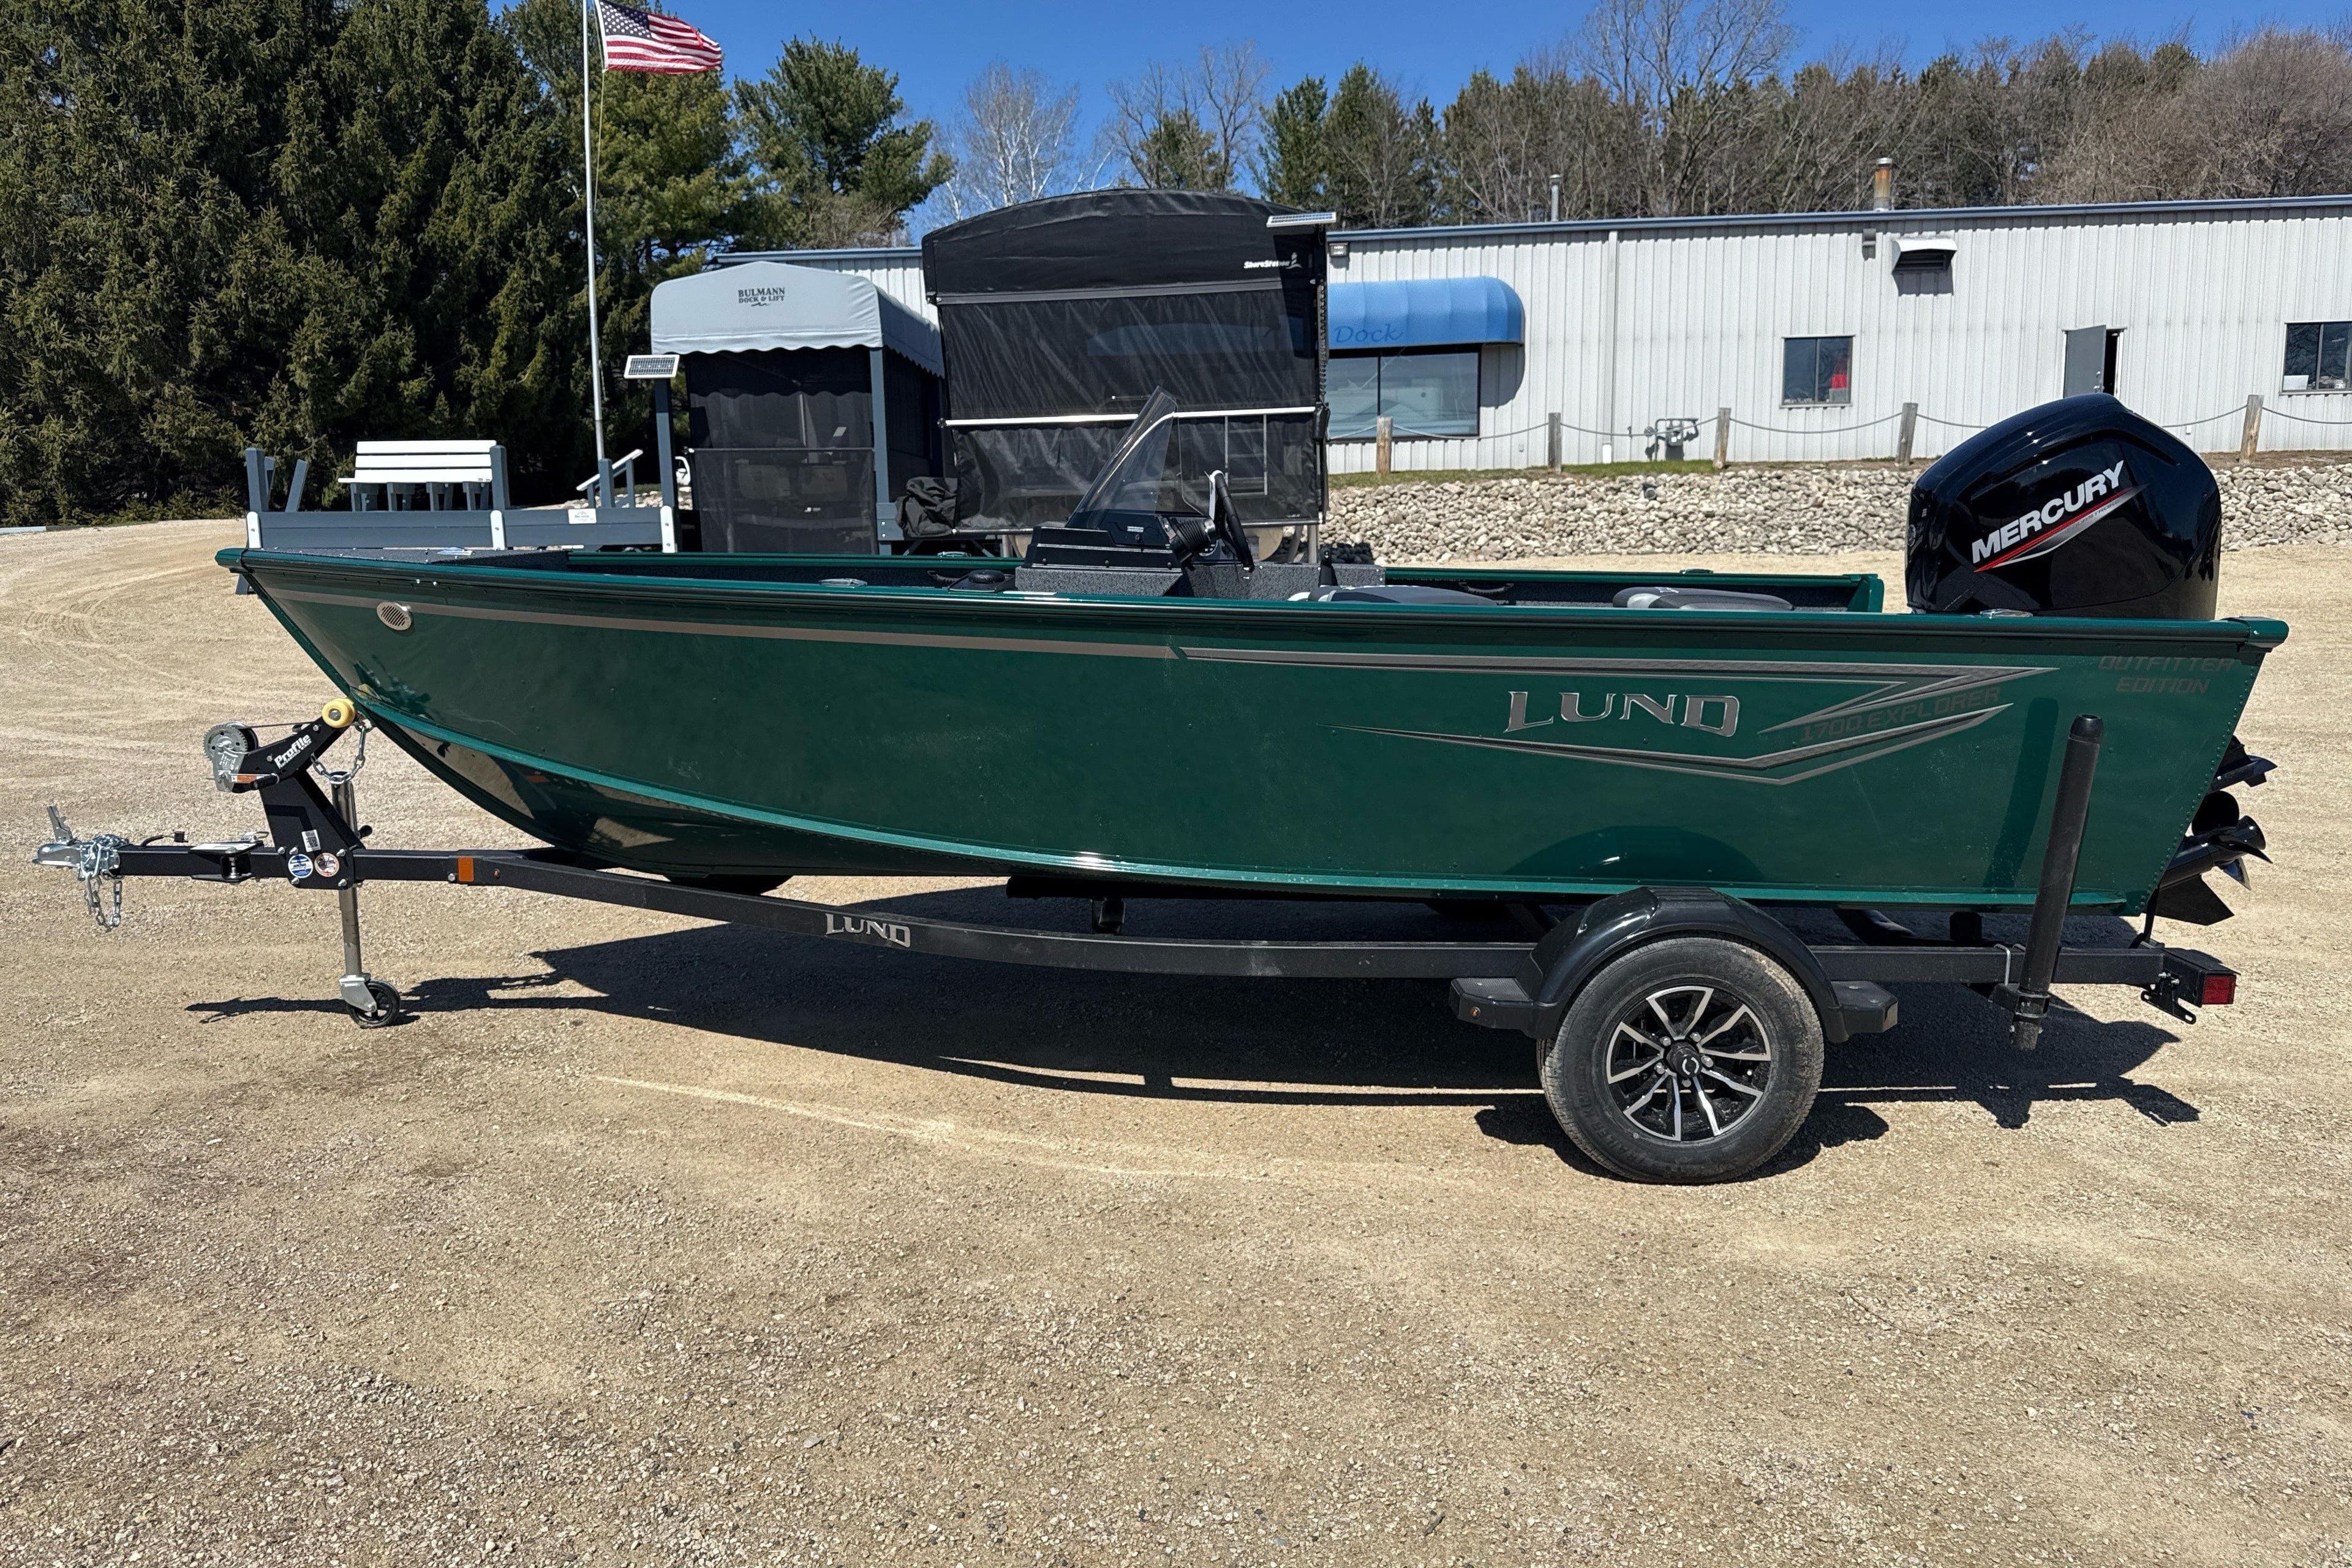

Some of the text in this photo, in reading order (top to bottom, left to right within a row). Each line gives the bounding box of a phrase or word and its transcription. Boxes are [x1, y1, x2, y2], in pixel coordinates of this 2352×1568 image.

[738, 287, 785, 298] BULMANN
[1334, 323, 1403, 343] Dock
[1972, 460, 2124, 564] MERCURY
[2098, 655, 2235, 672] OUTFITTER
[2116, 677, 2210, 694] EDITION
[1502, 691, 1740, 737] LUND
[1803, 687, 2001, 742] 1700 EXPLORER
[274, 734, 311, 769] Profile
[825, 913, 911, 948] LUND
